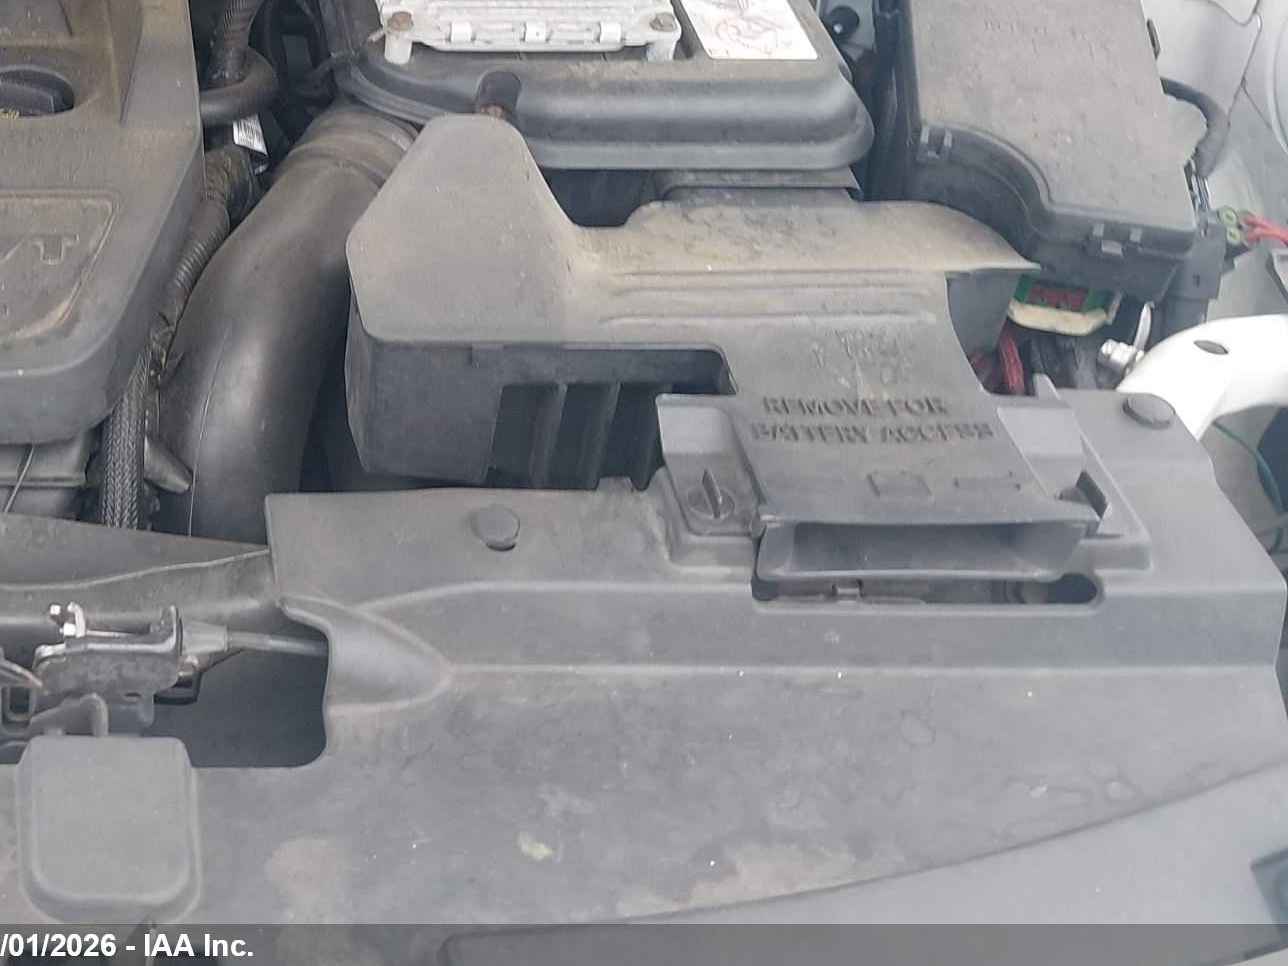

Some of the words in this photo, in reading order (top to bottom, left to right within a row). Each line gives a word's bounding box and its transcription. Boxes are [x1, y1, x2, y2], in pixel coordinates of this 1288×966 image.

[761, 396, 877, 416] REMOVE
[884, 396, 948, 416] FOR
[749, 422, 871, 443] BATTERY
